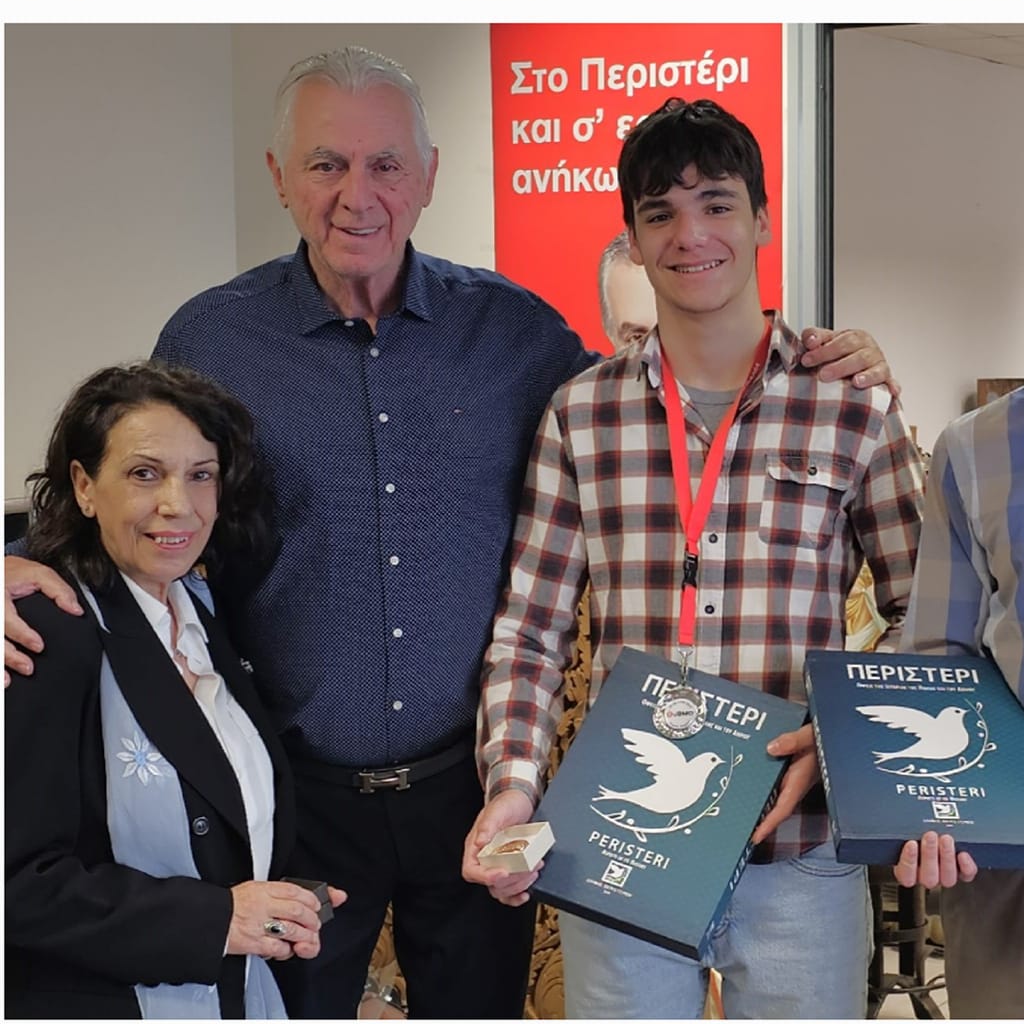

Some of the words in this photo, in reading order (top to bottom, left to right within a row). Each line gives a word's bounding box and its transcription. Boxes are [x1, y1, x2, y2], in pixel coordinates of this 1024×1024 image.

[510, 61, 569, 94] Στο
[580, 50, 749, 97] Περιστέρι
[512, 118, 560, 144] και
[512, 160, 619, 194] ανήκω
[846, 664, 979, 684] ΠΕΡΙΣΤΕΡΙ
[641, 674, 767, 731] ΠΕΤΕΡΙ
[895, 783, 986, 798] PERISTERI
[588, 831, 671, 870] PERISTERI
